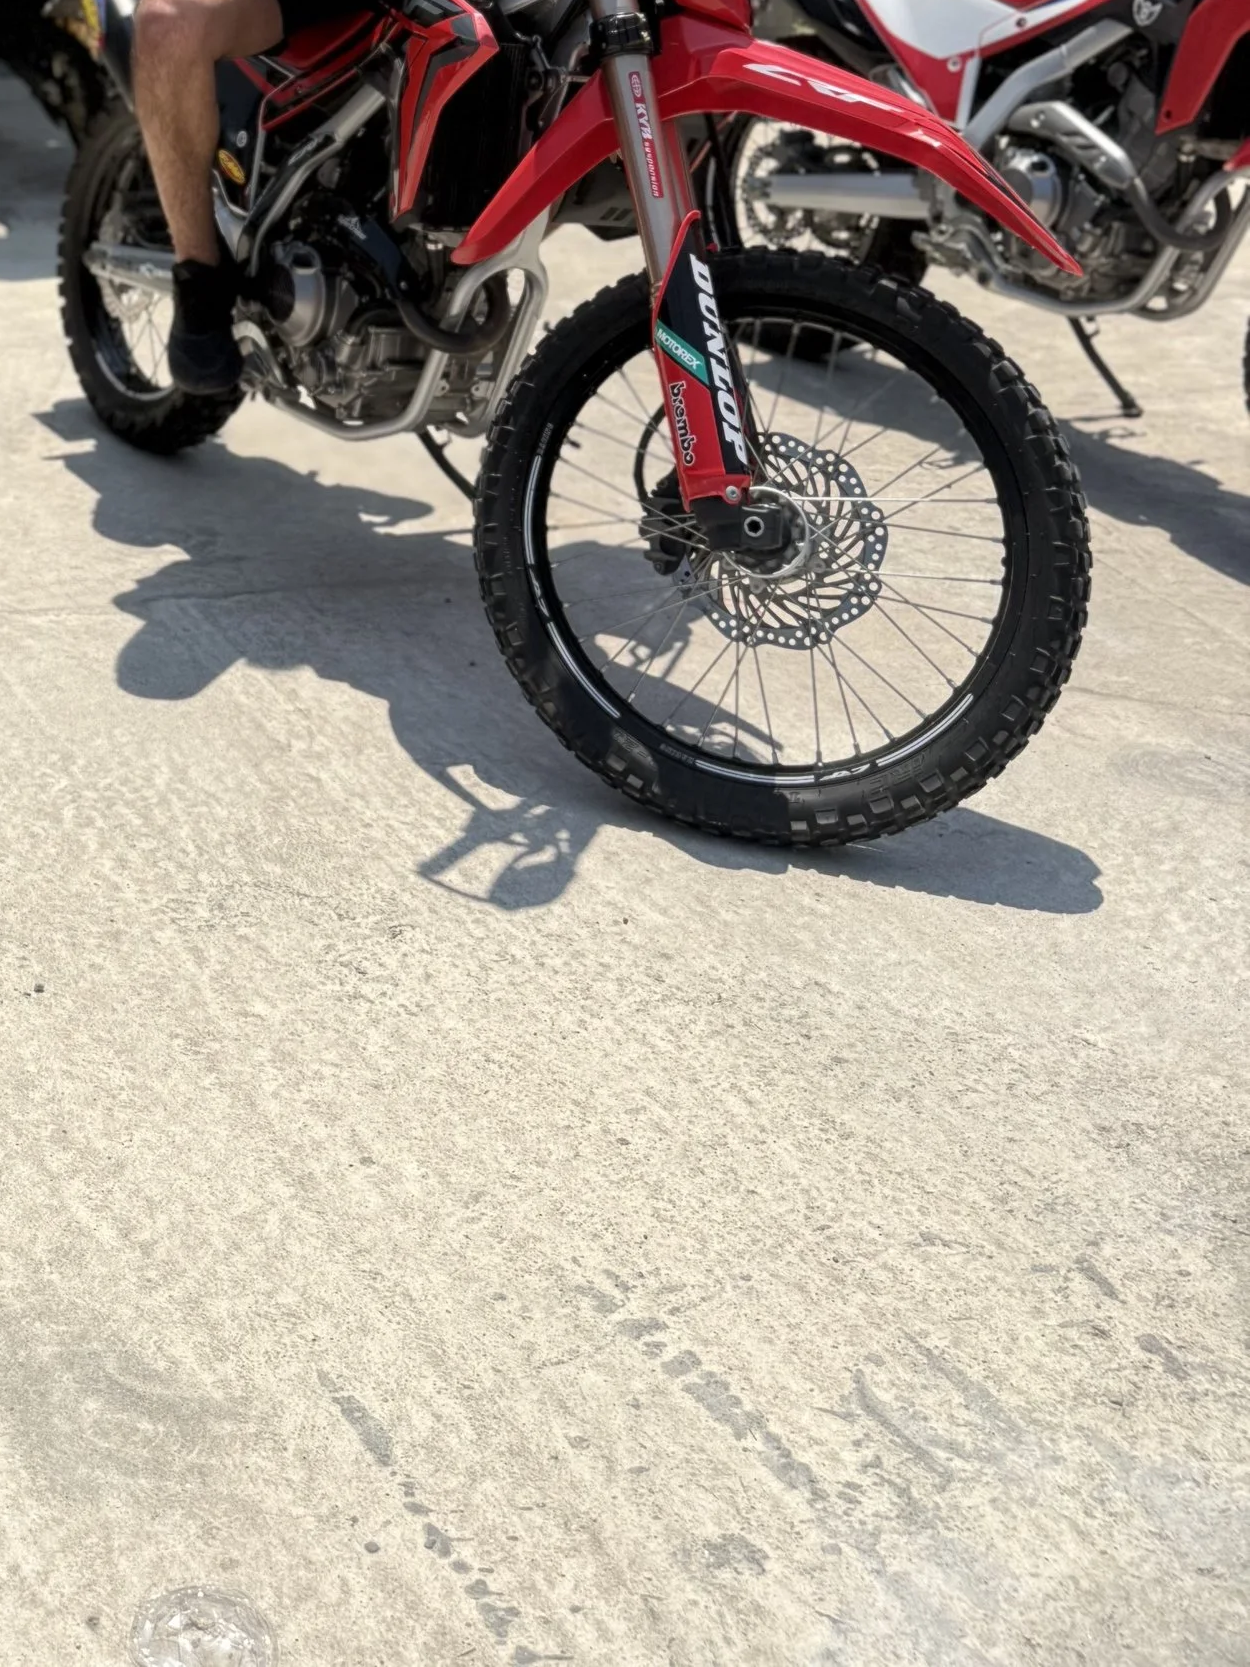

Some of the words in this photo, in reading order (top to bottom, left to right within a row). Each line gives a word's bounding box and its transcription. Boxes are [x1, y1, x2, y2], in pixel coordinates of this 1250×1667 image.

[635, 102, 653, 140] KYB
[643, 141, 660, 197] suspension
[656, 328, 703, 370] MOTOREX
[689, 253, 749, 466] DUNLOP
[669, 381, 697, 466] brembo
